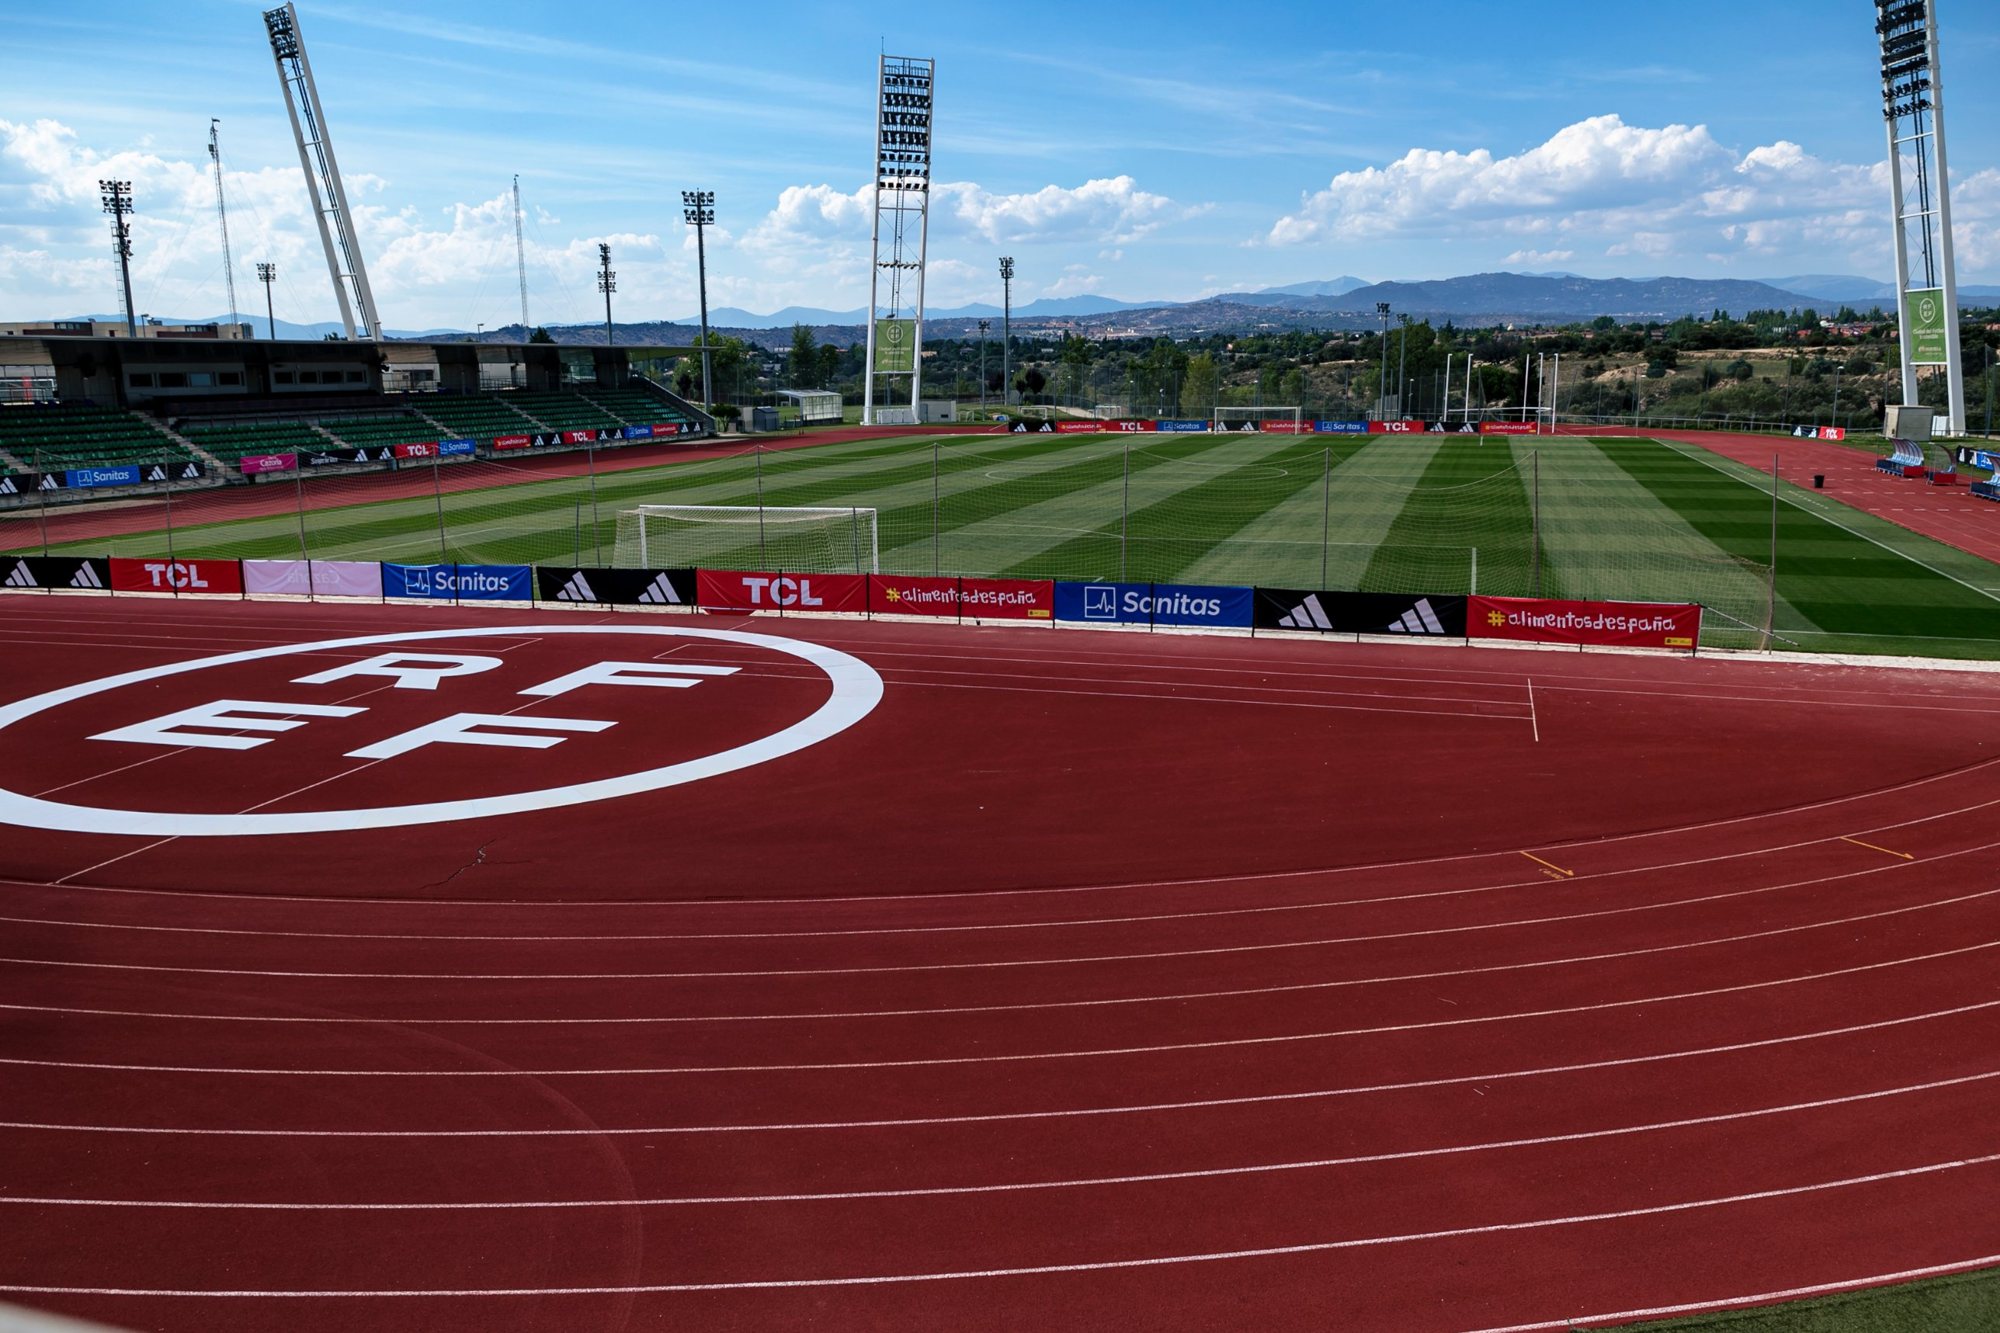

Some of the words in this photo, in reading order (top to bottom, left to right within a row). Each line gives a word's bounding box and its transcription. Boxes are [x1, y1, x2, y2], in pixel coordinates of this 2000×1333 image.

[1120, 422, 1144, 431] TCL
[1383, 422, 1409, 431] TCL
[573, 432, 588, 441] TCL
[407, 445, 429, 456] TCL
[448, 442, 470, 452] Sanitas
[93, 470, 130, 482] Sanitas
[144, 563, 208, 588] TCL
[435, 571, 509, 591] Sanitas
[742, 577, 823, 606] TCL
[1122, 591, 1221, 616] Sanitas
[1487, 610, 1675, 633] #alimentosdespaña
